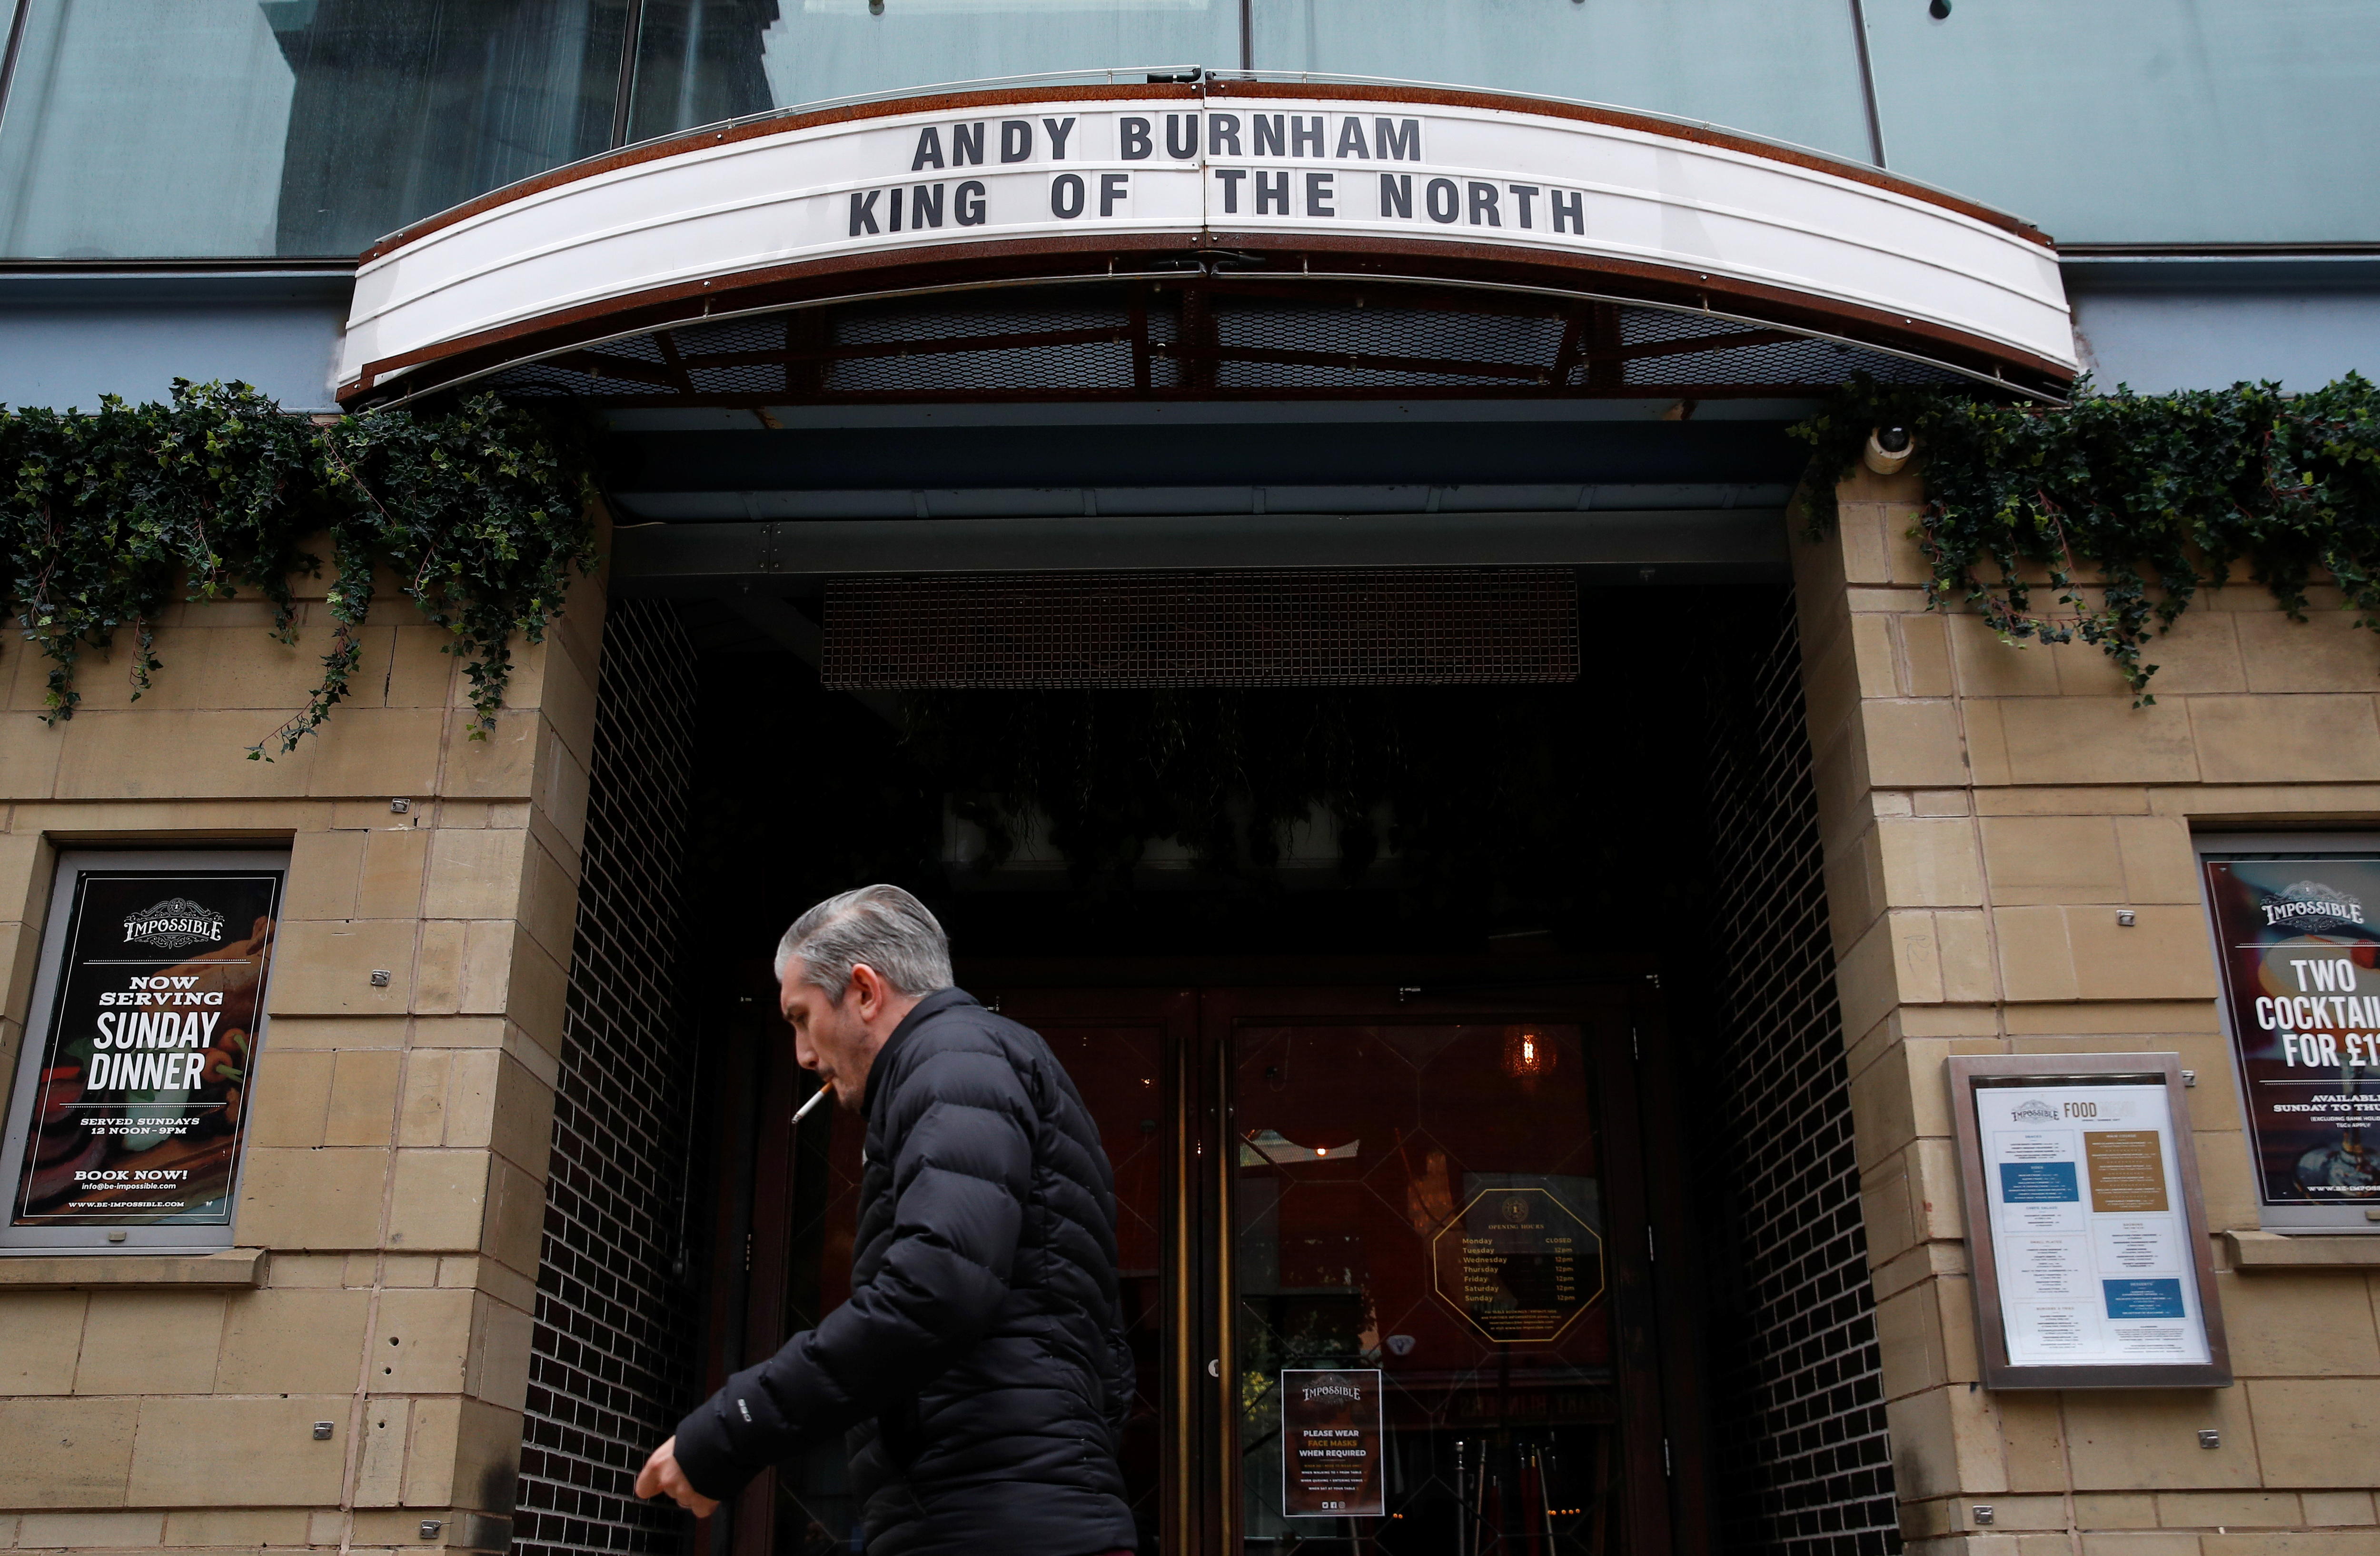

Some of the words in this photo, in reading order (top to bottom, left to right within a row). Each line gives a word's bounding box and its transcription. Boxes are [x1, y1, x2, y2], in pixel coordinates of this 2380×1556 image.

[911, 117, 1076, 171] ANDY
[1120, 113, 1421, 161] BURNHAM
[849, 180, 986, 236] KING
[1051, 173, 1129, 219] OF
[1215, 170, 1334, 217] THE
[1380, 173, 1584, 235] NORTH
[2261, 900, 2365, 926] IMPOSSIBLE
[123, 918, 223, 943] IMPOSSIBLE
[129, 976, 199, 989] NOW
[2289, 958, 2357, 992] TWO
[99, 992, 224, 1006] SERVING
[93, 1011, 221, 1049] SUNDAY
[2281, 1033, 2340, 1067] FOR
[87, 1053, 206, 1090] DINNER
[2011, 1109, 2060, 1122] IMPOSSIBLE
[2063, 1102, 2097, 1118] FOOD
[2273, 1104, 2328, 1112] SUNDAY
[2330, 1104, 2352, 1112] TO
[137, 1117, 200, 1126] SUNDAYS
[74, 1170, 129, 1181] BOOK
[133, 1170, 188, 1181] NOW!
[81, 1183, 176, 1191] info@be-impossible.com
[1302, 1386, 1360, 1401] IMPOSSIBLE
